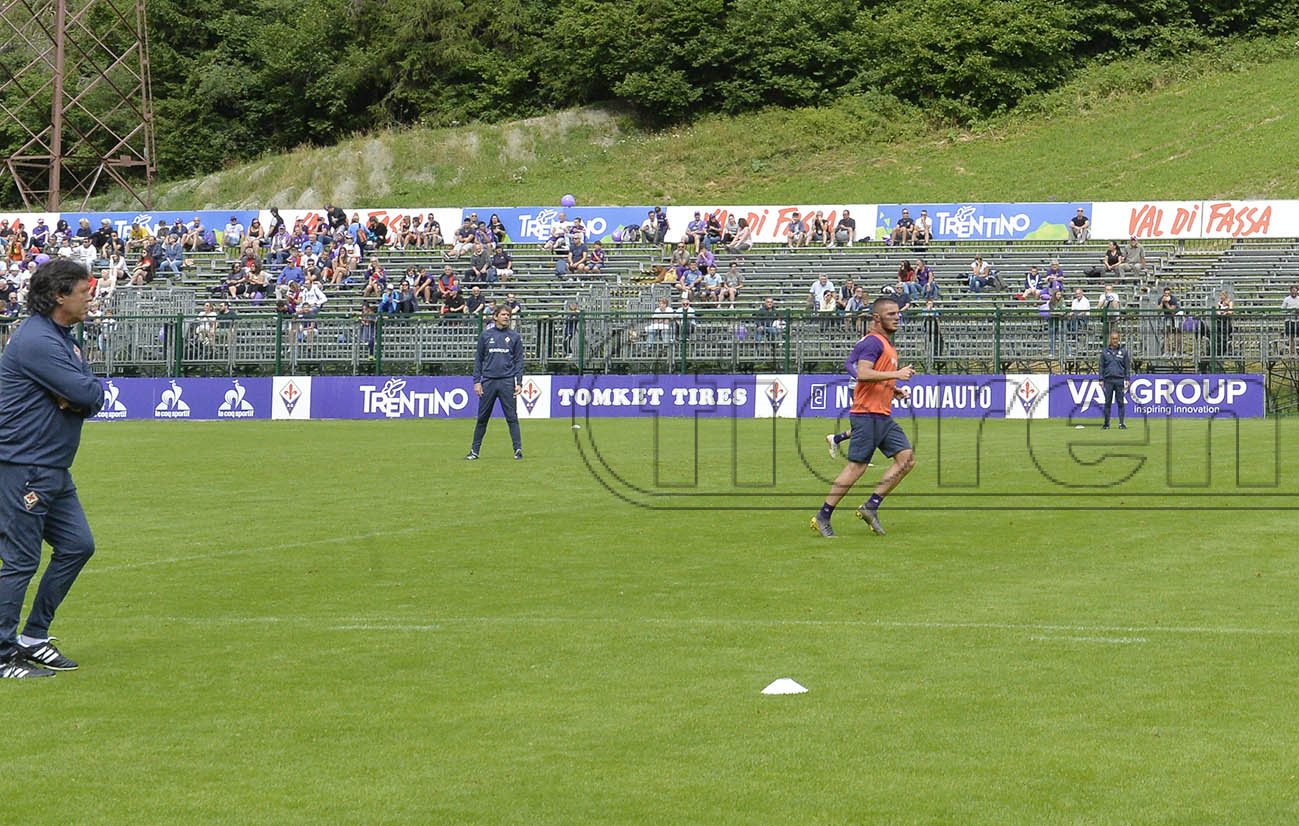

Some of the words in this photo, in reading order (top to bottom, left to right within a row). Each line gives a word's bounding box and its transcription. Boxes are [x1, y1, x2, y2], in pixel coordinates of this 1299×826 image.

[936, 212, 1030, 238] TRENTINO
[1129, 204, 1164, 237] VAL
[1206, 203, 1272, 236] FASSA
[360, 385, 468, 418] TRENTINO
[558, 388, 664, 406] TOMKET
[671, 388, 748, 406] TIRES
[1066, 378, 1248, 413] VAGROUP
[1134, 404, 1171, 415] inspiring
[1174, 404, 1220, 414] innovation
